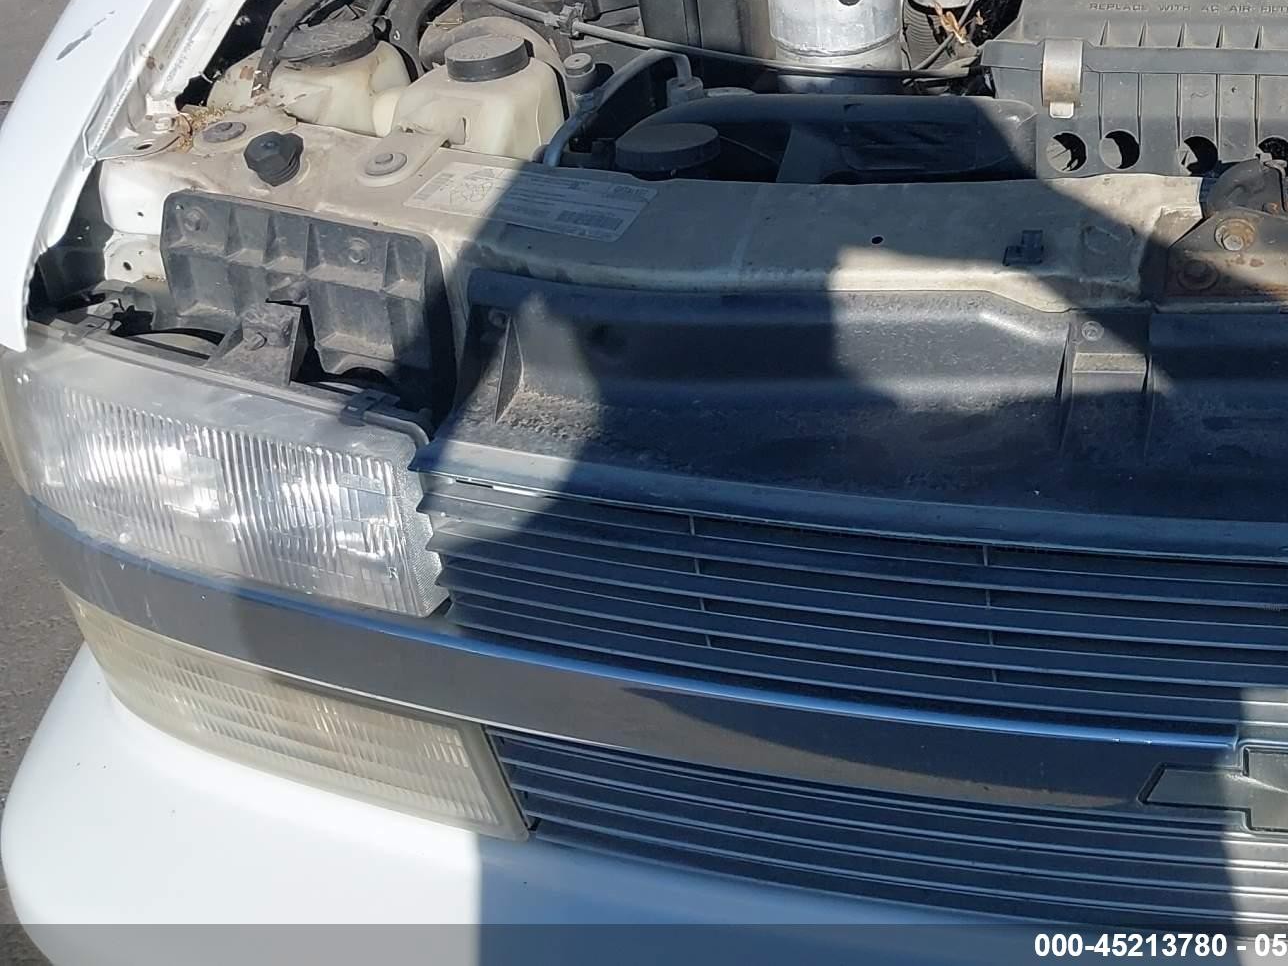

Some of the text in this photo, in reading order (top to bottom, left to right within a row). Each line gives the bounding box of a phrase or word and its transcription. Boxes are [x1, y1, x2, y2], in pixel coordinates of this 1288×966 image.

[1088, 2, 1148, 11] REPLACE
[1158, 3, 1191, 12] WITH
[1229, 4, 1250, 13] AIR
